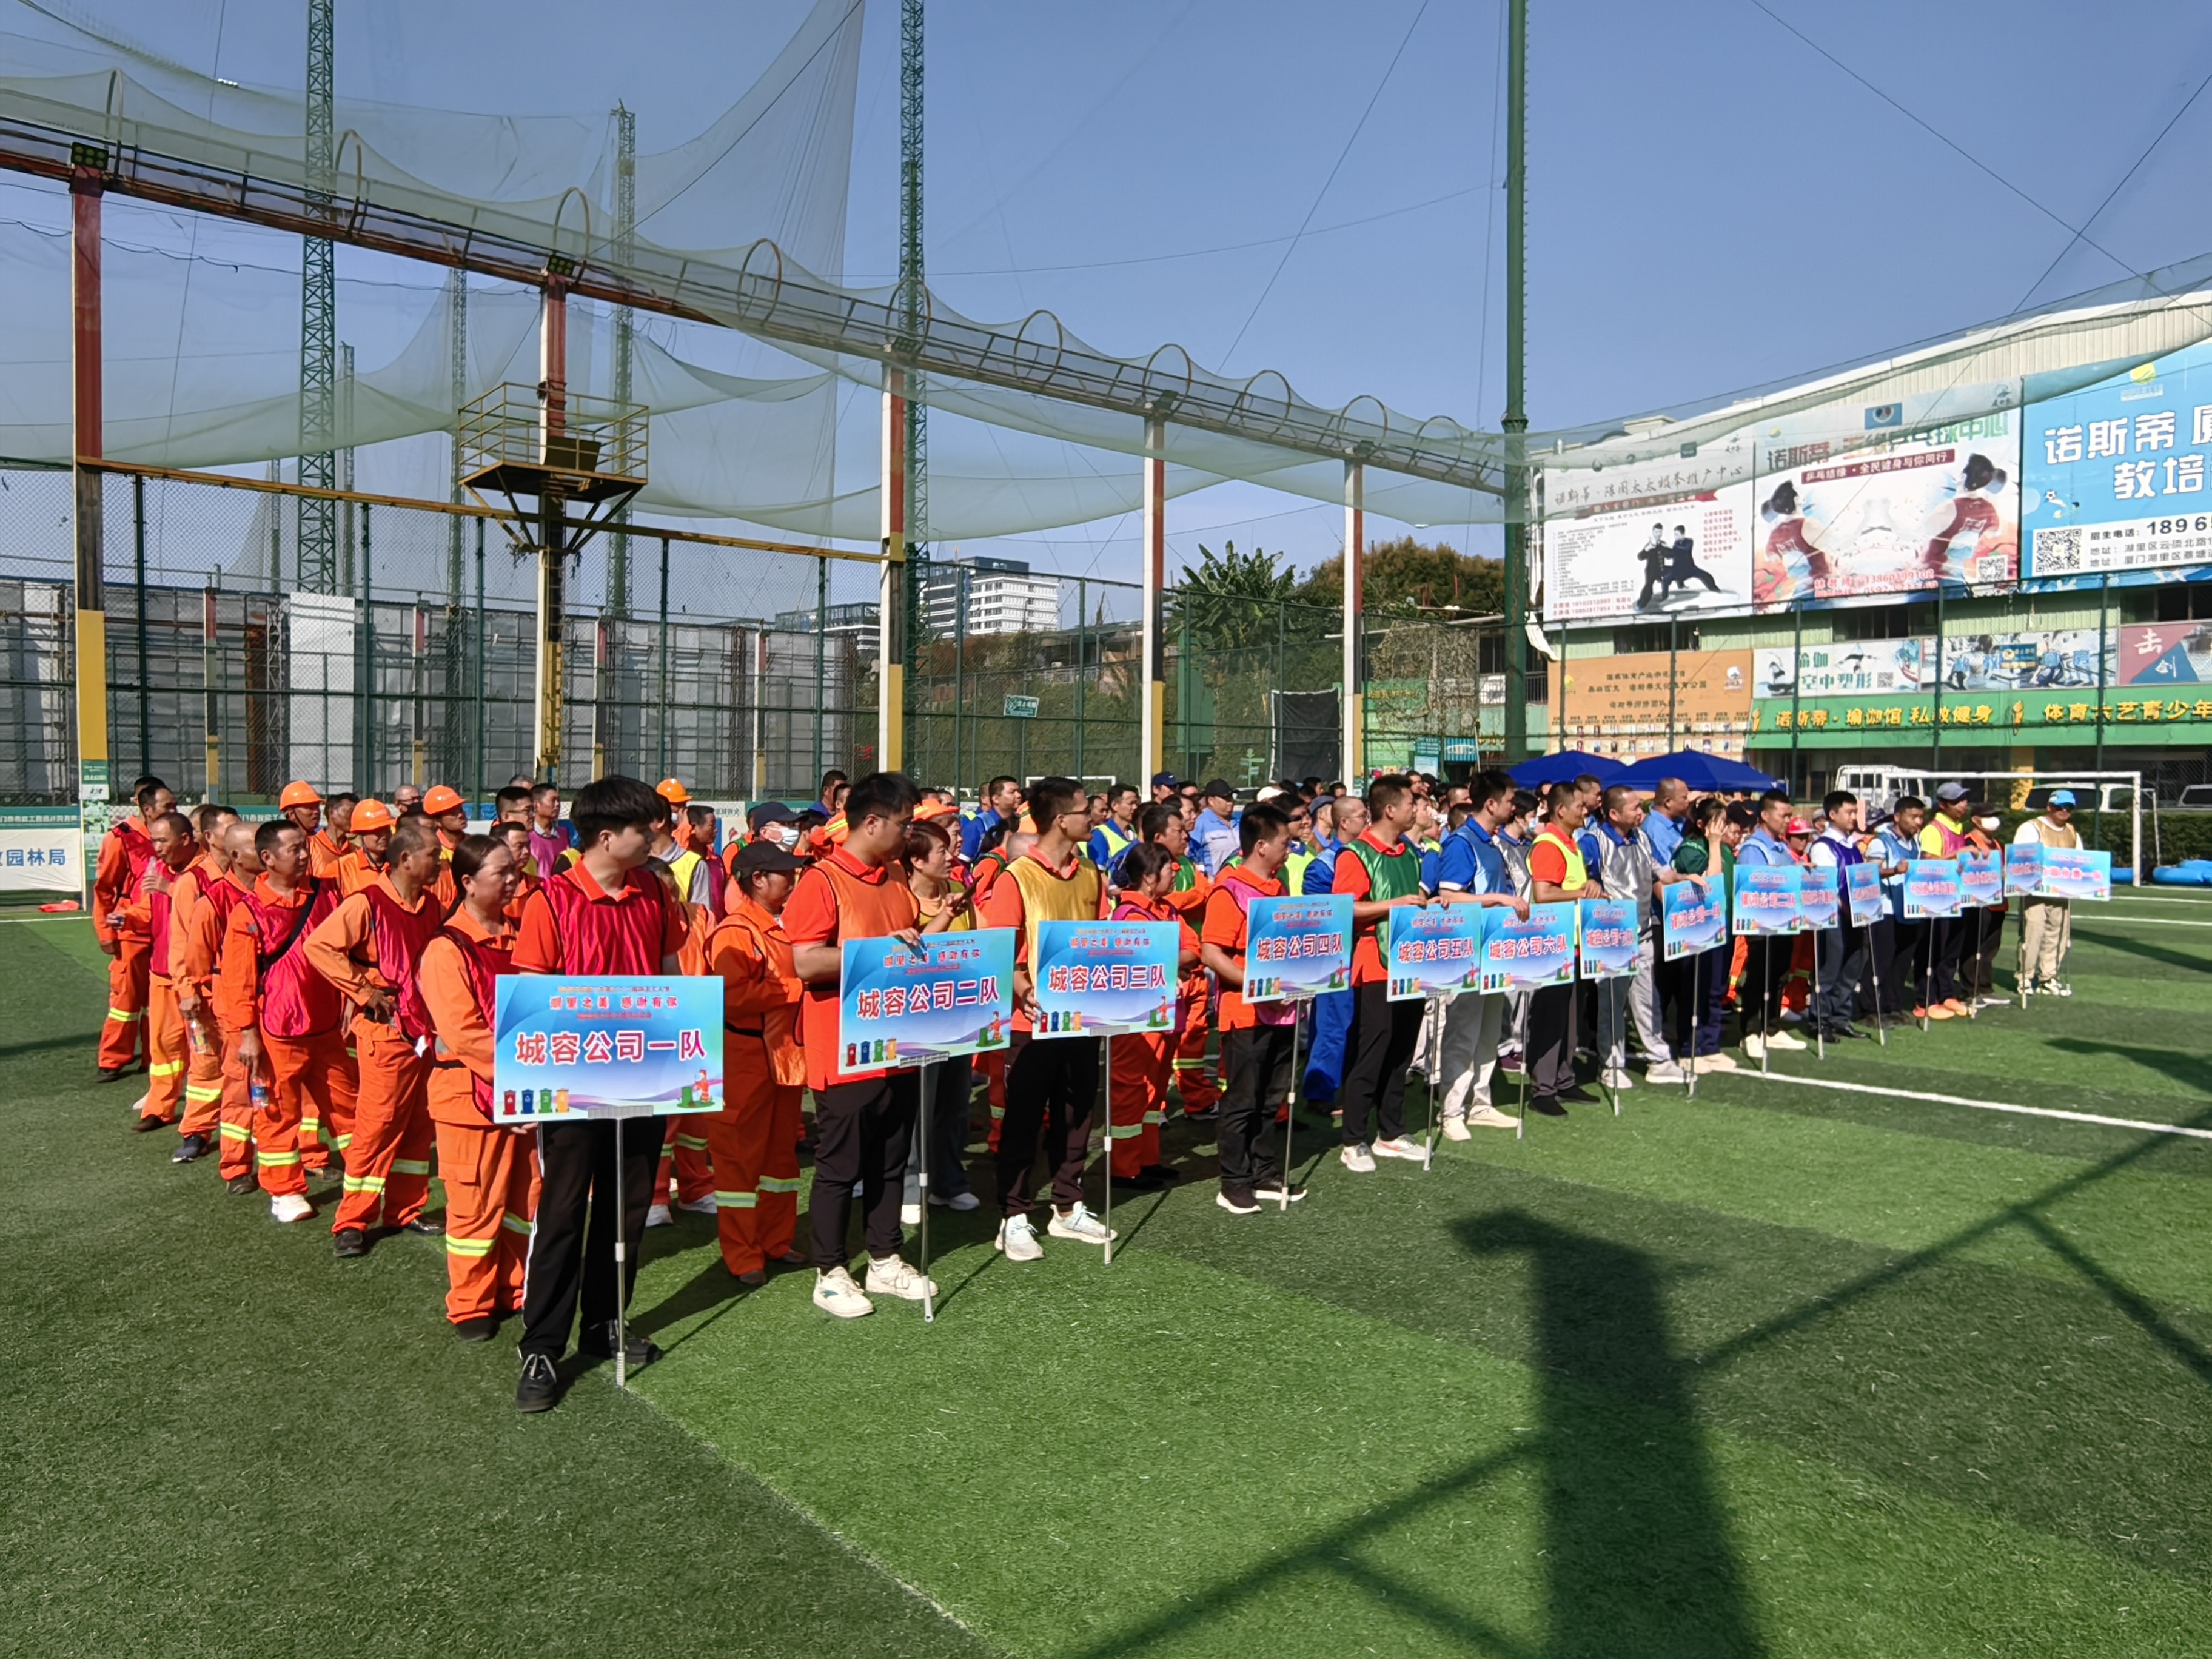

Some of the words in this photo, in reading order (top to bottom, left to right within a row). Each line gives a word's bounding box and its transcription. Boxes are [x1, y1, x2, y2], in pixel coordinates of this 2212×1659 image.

[2044, 411, 2176, 464] 诺斯蒂
[2114, 454, 2205, 500] 教培
[2147, 518, 2188, 535] 189
[2134, 627, 2162, 655] 击
[2154, 656, 2177, 679] 剑
[1048, 964, 1167, 993] 城容公司三队
[857, 976, 1000, 1021] 城容公司二队
[515, 1030, 706, 1065] 城容公司一队
